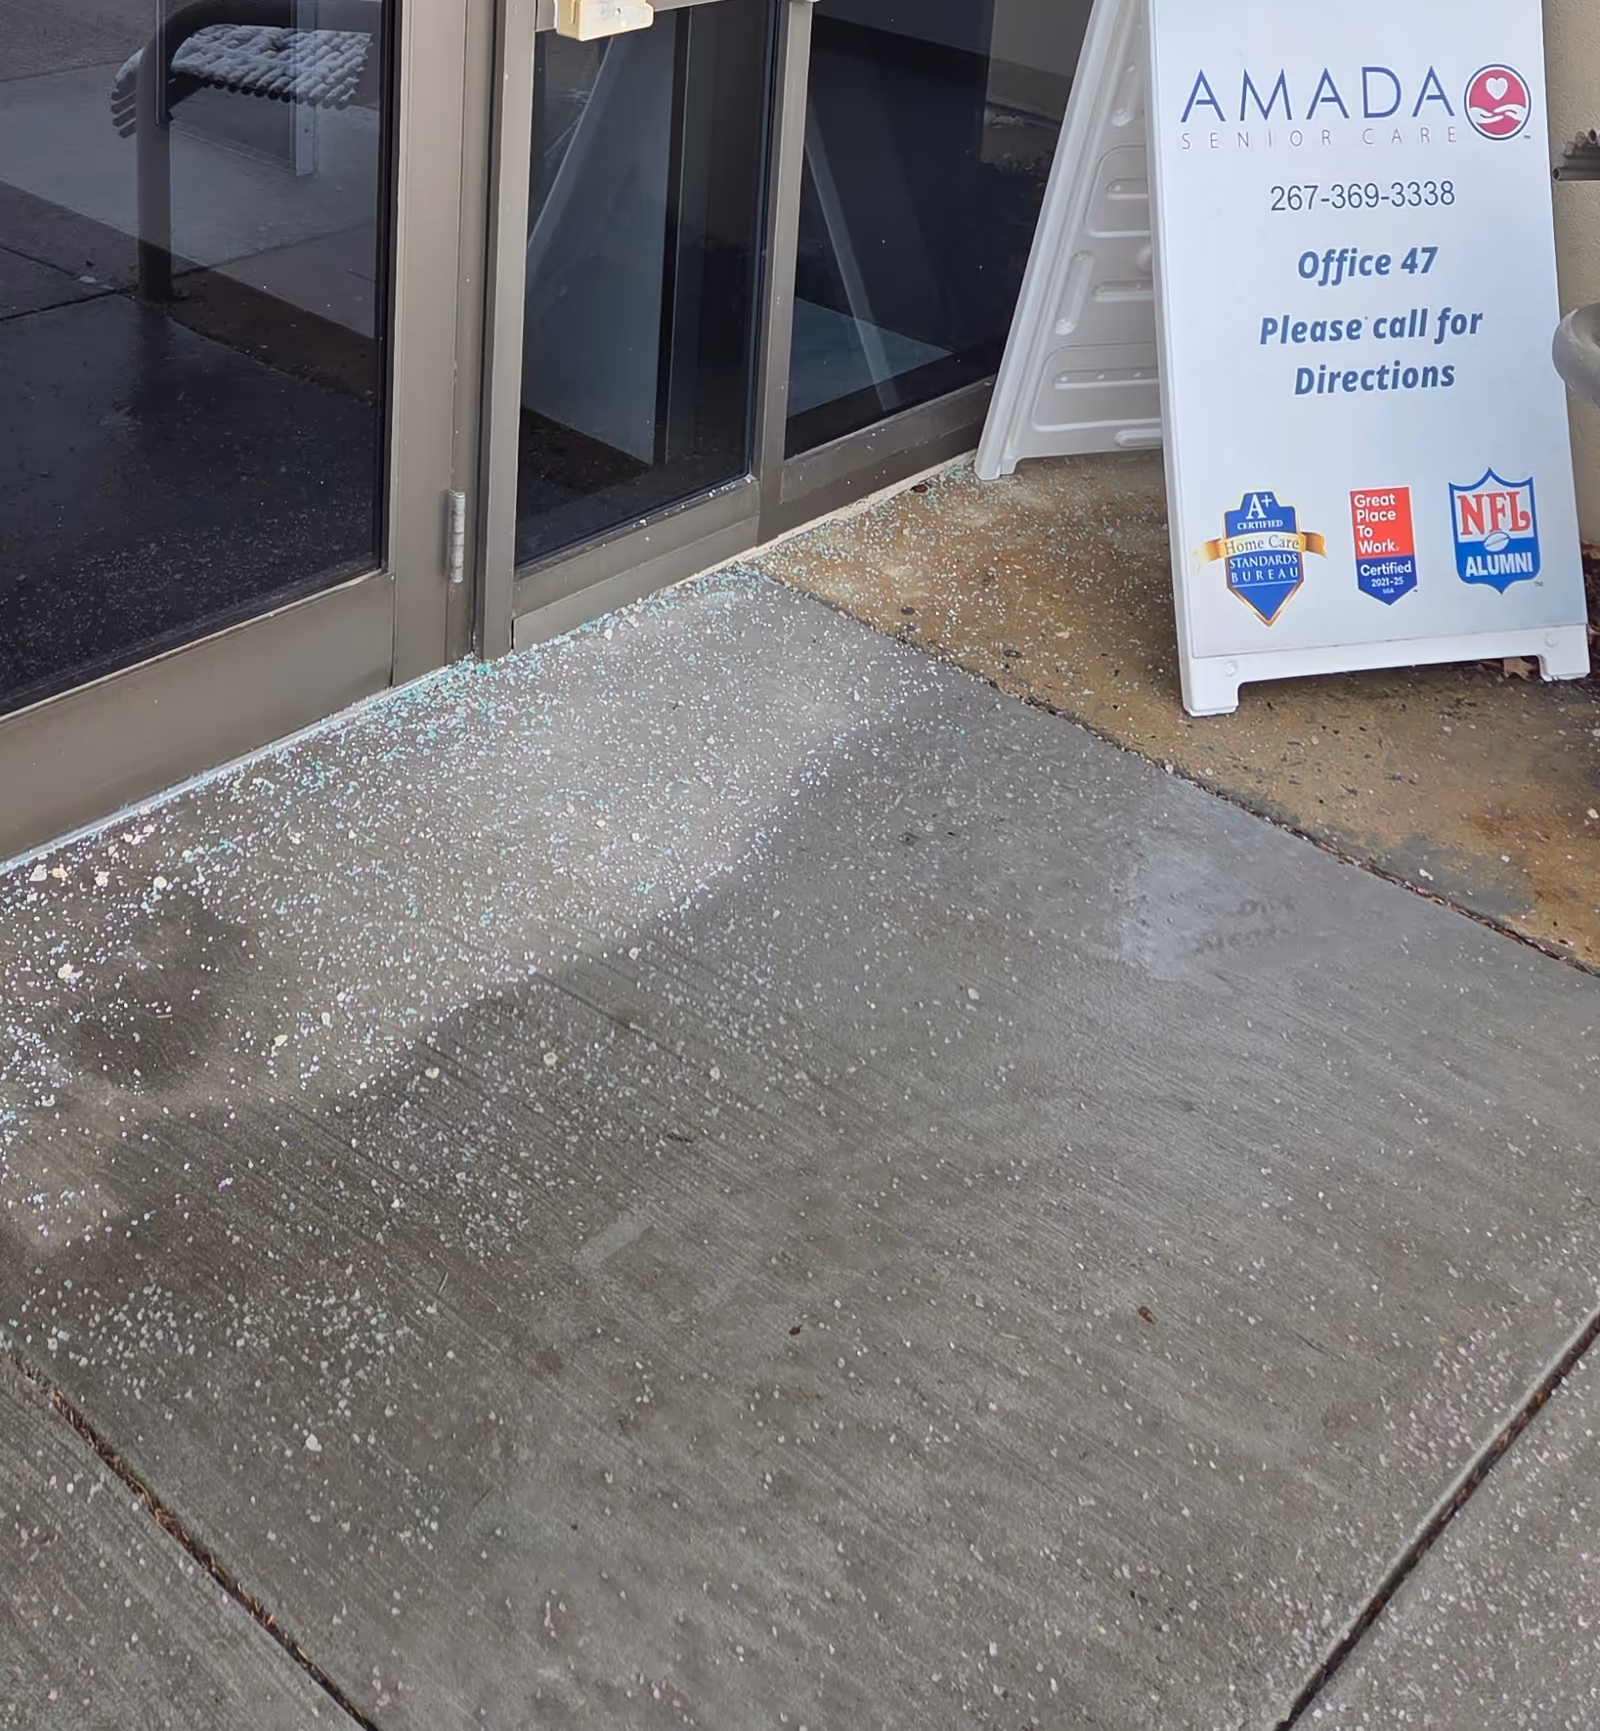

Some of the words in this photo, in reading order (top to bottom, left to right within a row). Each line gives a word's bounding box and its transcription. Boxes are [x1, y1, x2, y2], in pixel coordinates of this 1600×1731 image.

[1180, 66, 1456, 123] AMADA
[1181, 129, 1332, 150] SENIOR
[1361, 126, 1458, 146] CARE
[1270, 180, 1456, 212] 267-369-3338
[1297, 247, 1392, 287] Office
[1400, 246, 1439, 275] 47
[1259, 314, 1363, 345] Please
[1372, 308, 1429, 339] call
[1432, 307, 1483, 345] for
[1294, 361, 1456, 396] Directions
[1246, 494, 1273, 520] A+
[1354, 493, 1396, 508] Great
[1356, 509, 1397, 524] Place
[1457, 491, 1531, 535] NFL
[1236, 519, 1284, 530] CERTIFIED
[1356, 525, 1374, 538] To
[1224, 539, 1265, 555] Home
[1268, 534, 1300, 550] Care
[1229, 553, 1298, 569] STANDARDS
[1360, 560, 1412, 576] Certified
[1465, 552, 1534, 577] ALUMNI
[1231, 567, 1298, 583] BUREAU
[1371, 576, 1404, 587] 2021-25
